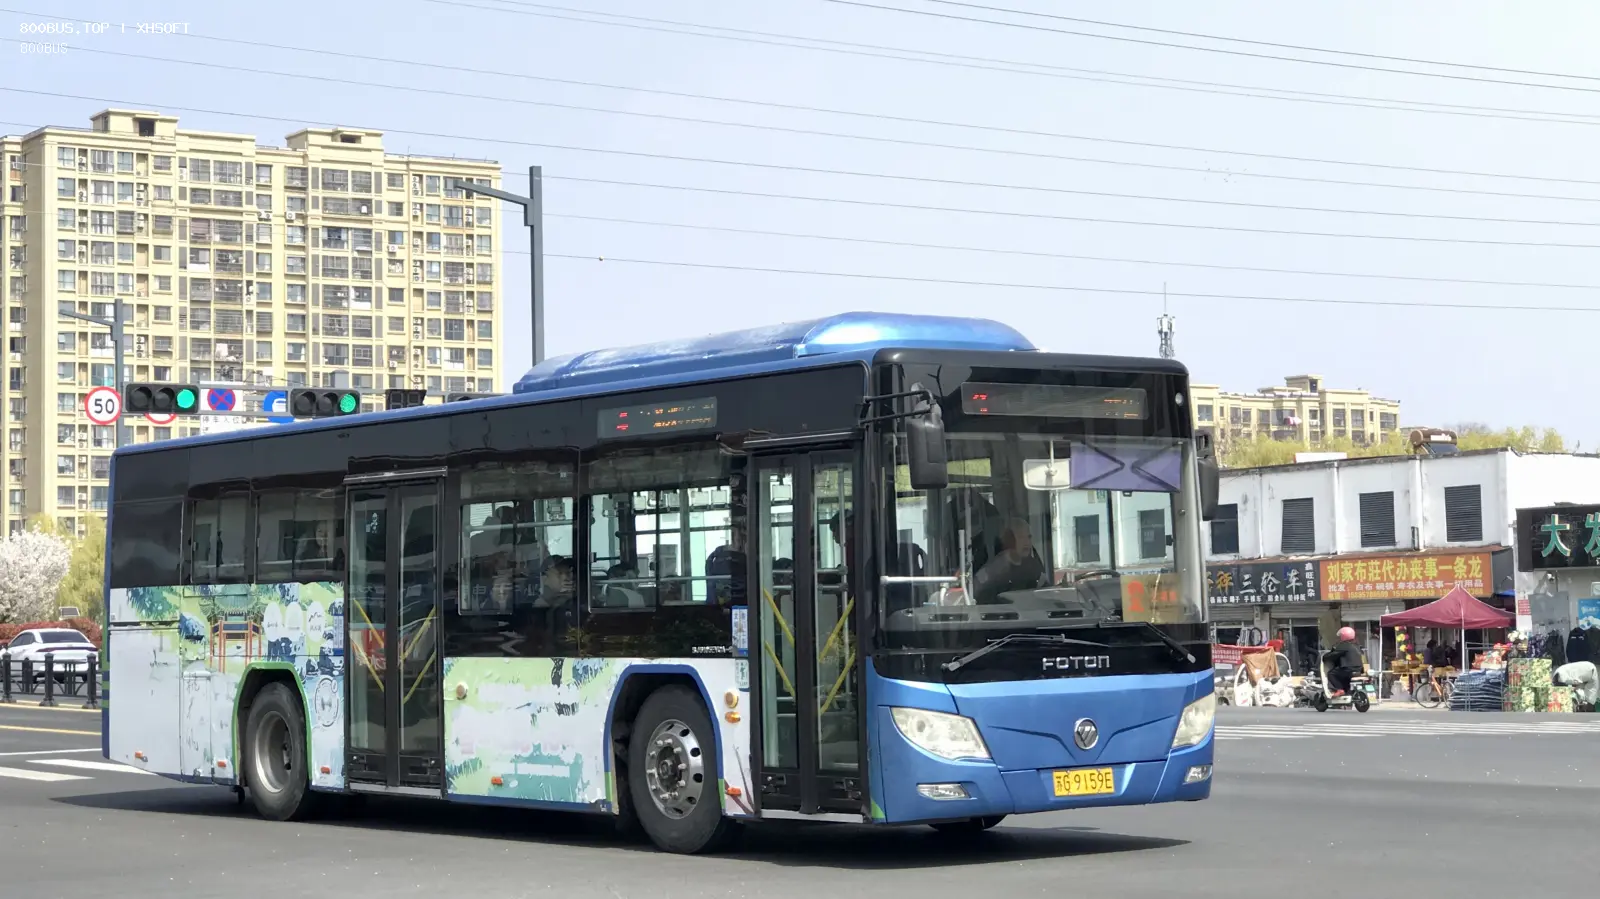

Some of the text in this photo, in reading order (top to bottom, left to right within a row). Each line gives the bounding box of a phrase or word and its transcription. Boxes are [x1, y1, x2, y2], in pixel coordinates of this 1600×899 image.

[94, 398, 115, 414] 50
[1042, 655, 1110, 670] FOTON
[1055, 771, 1113, 793] 苏G9159E
